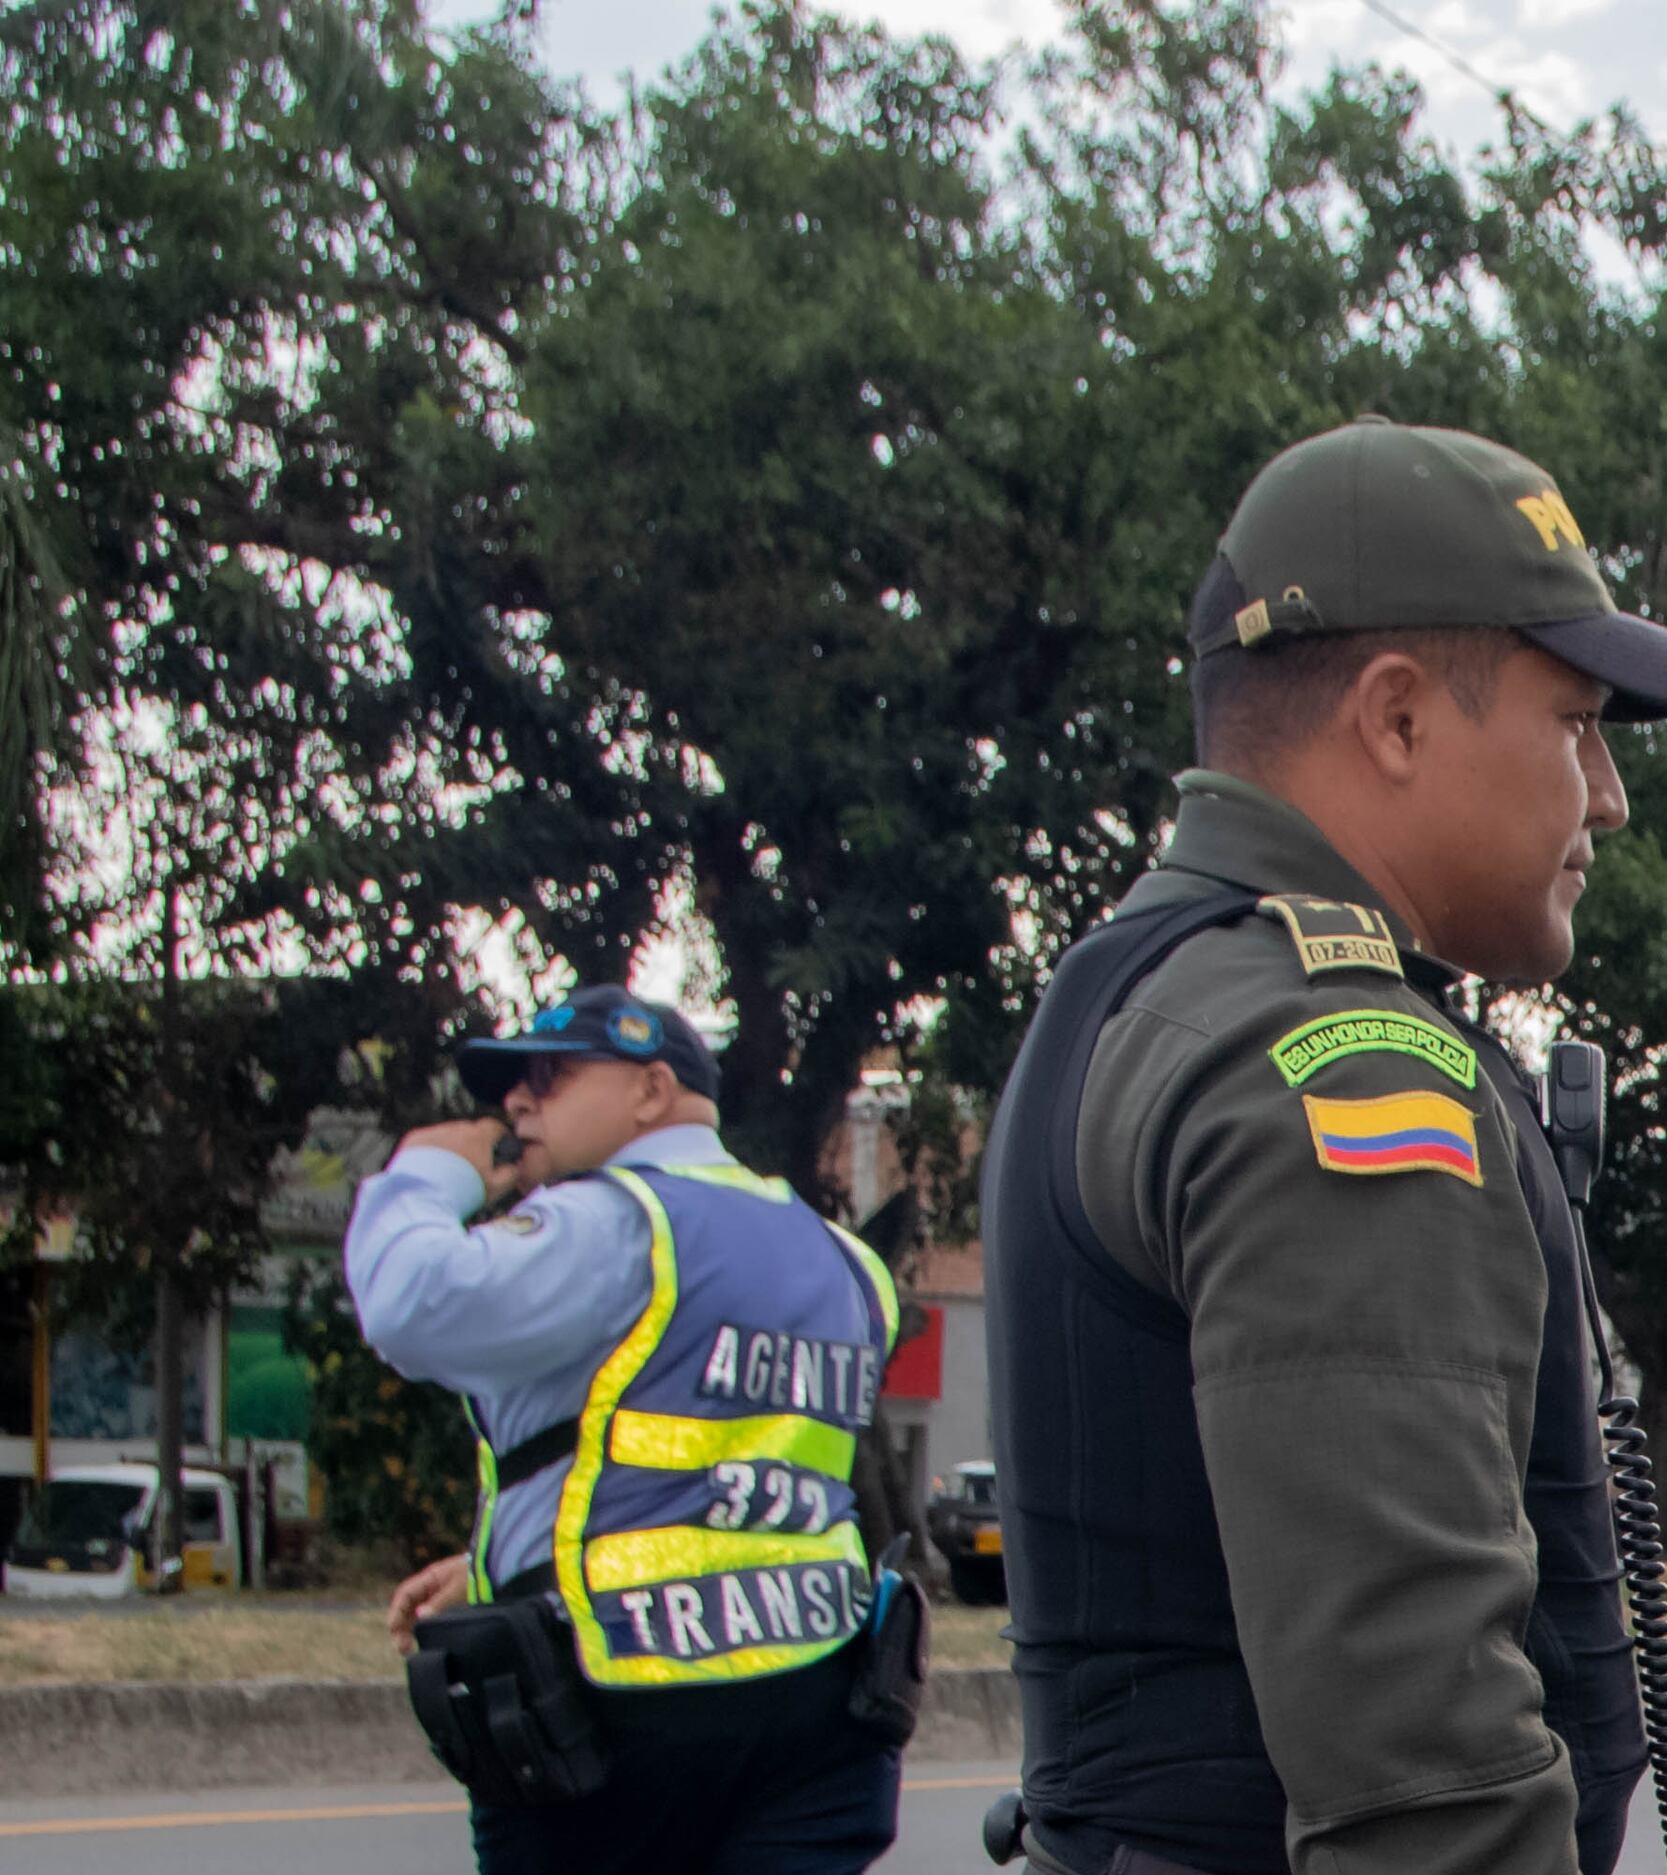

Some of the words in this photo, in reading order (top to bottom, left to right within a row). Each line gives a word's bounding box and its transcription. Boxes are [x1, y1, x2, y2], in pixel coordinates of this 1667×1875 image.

[1284, 1045, 1310, 1073] ES
[1302, 1031, 1333, 1058] UN
[1326, 1020, 1387, 1048] HONOR
[1385, 1021, 1417, 1045] SER
[1414, 1030, 1468, 1076] POLICIA
[703, 1325, 878, 1426] AGENTE
[621, 1564, 870, 1656] TRANSI
